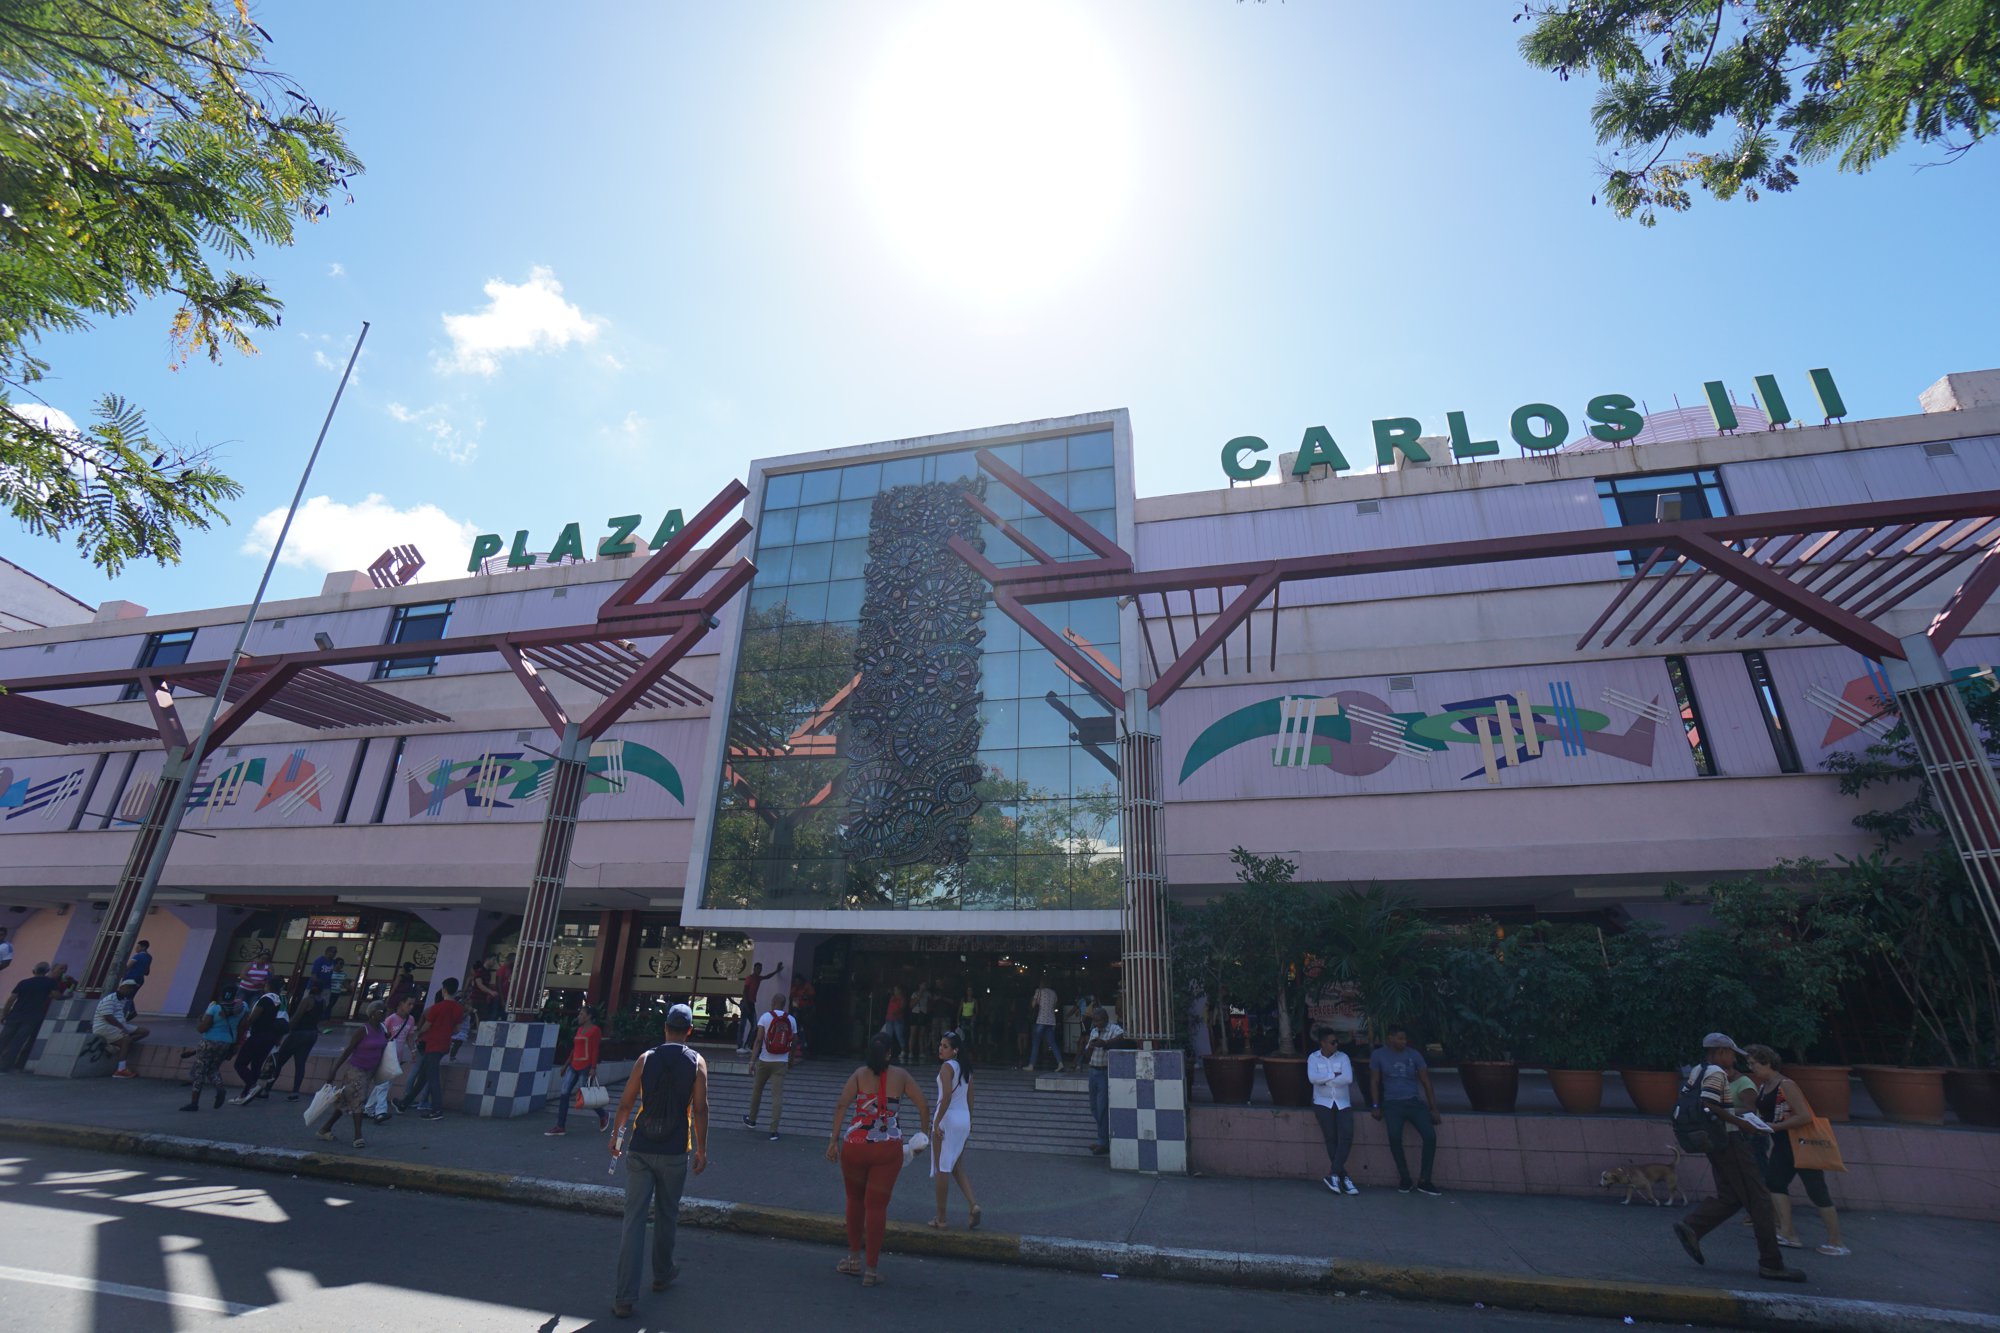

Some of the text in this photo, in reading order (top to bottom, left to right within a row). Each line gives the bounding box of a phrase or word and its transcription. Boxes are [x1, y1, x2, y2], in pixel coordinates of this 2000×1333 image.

[467, 368, 1848, 573] PLAZA CARLOS III
